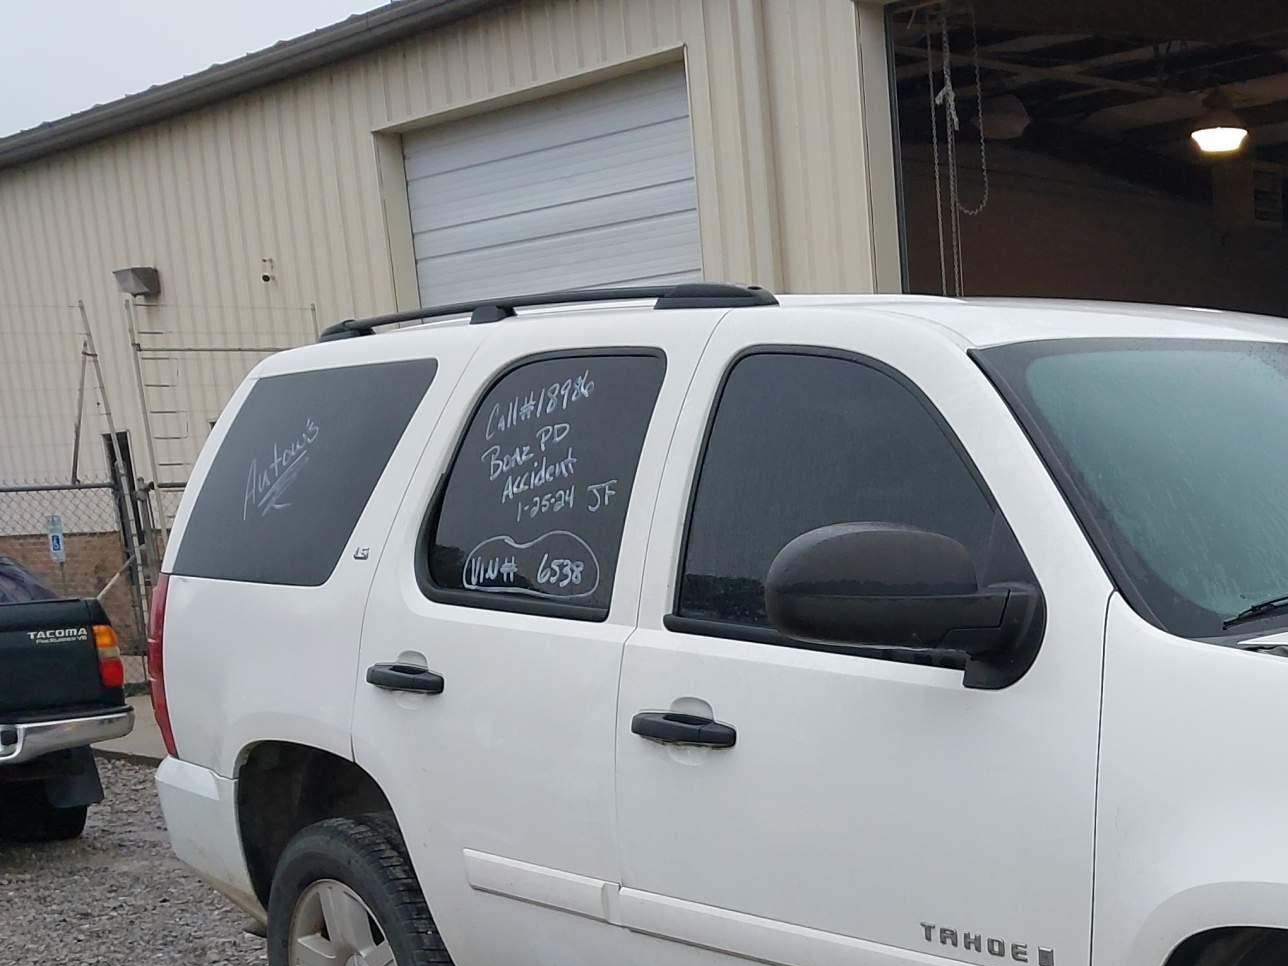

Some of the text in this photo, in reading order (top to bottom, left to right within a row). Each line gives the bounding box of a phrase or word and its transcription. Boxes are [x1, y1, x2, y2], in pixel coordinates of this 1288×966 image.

[536, 424, 570, 451] PD
[502, 448, 577, 503] Accident
[587, 480, 618, 512] JF
[470, 554, 584, 587] VIN# 6538
[27, 628, 88, 640] TACOMA
[921, 922, 1028, 962] TAHOE
